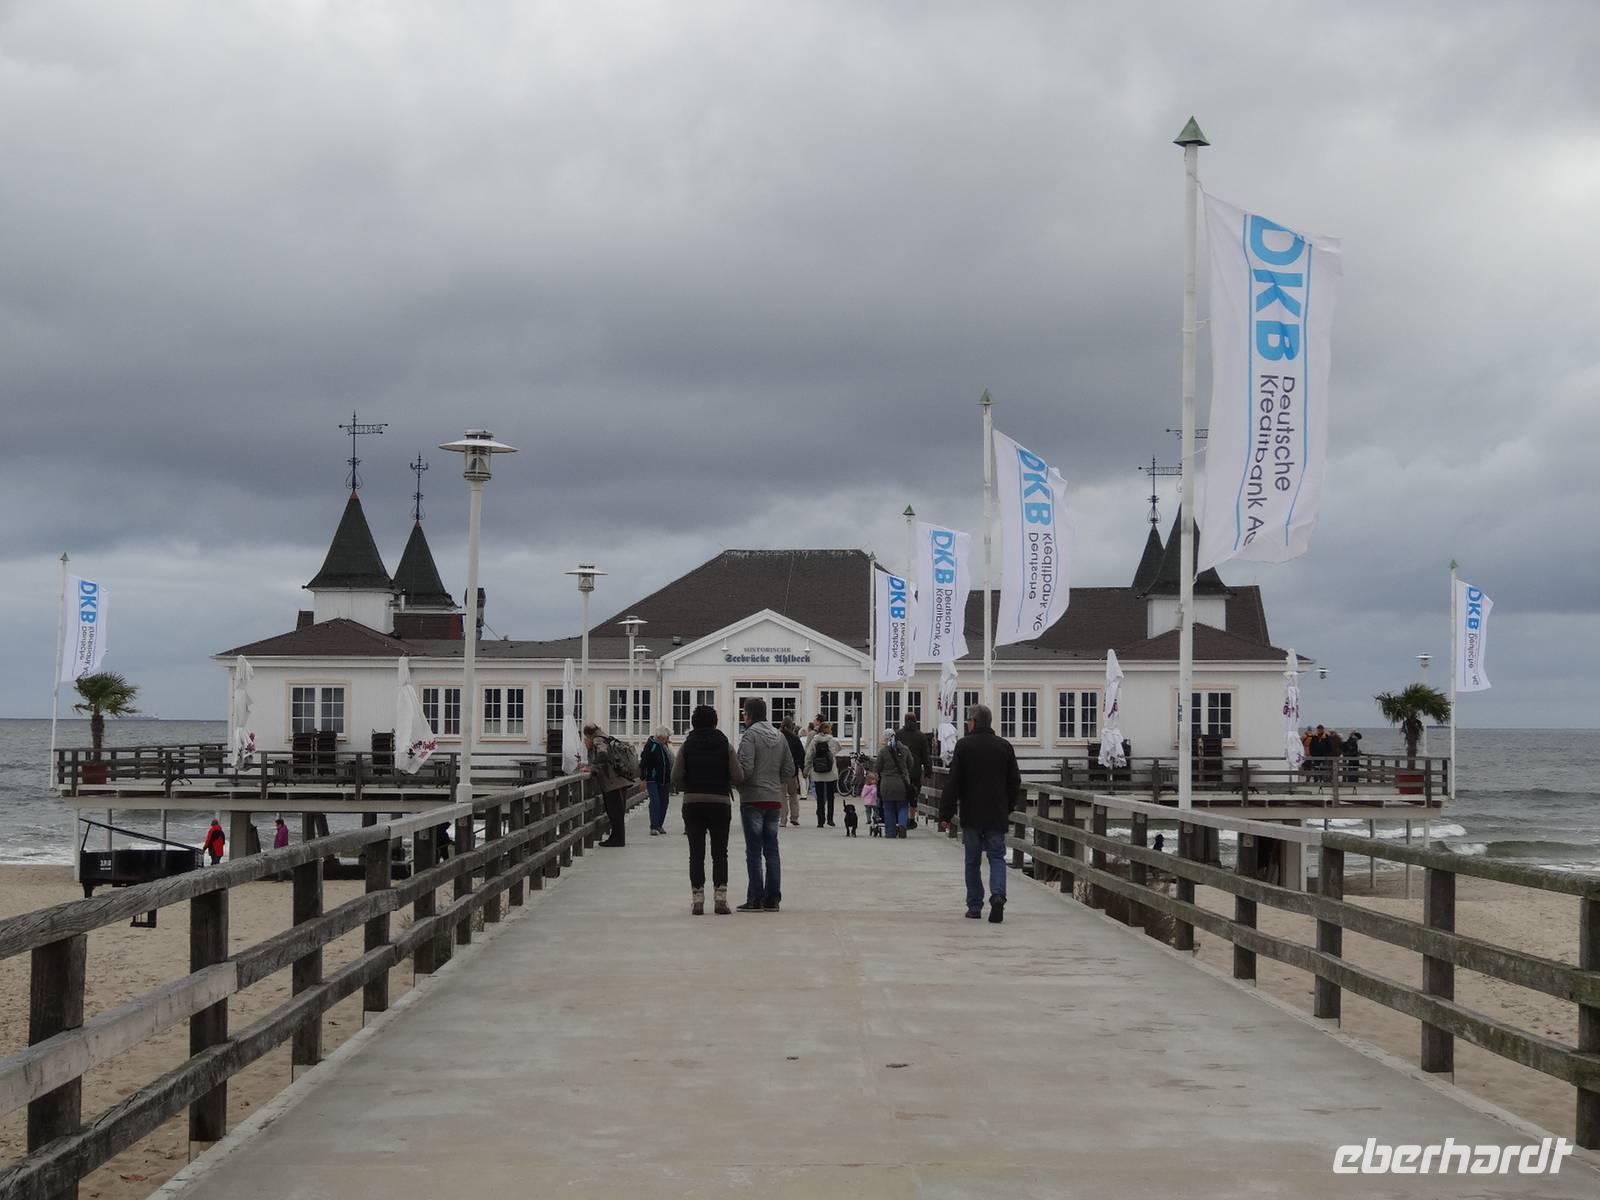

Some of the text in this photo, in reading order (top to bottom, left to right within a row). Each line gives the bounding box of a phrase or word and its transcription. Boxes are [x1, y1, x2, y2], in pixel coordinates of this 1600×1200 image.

[1250, 214, 1305, 361] DKB
[1247, 374, 1279, 510] Kreditbank
[1274, 375, 1295, 491] Deutsche
[931, 529, 955, 588] DKB
[932, 588, 943, 656] Kreditbank AG
[944, 588, 953, 634] Deutsche
[725, 653, 811, 664] Seebrücke Ahlbeck
